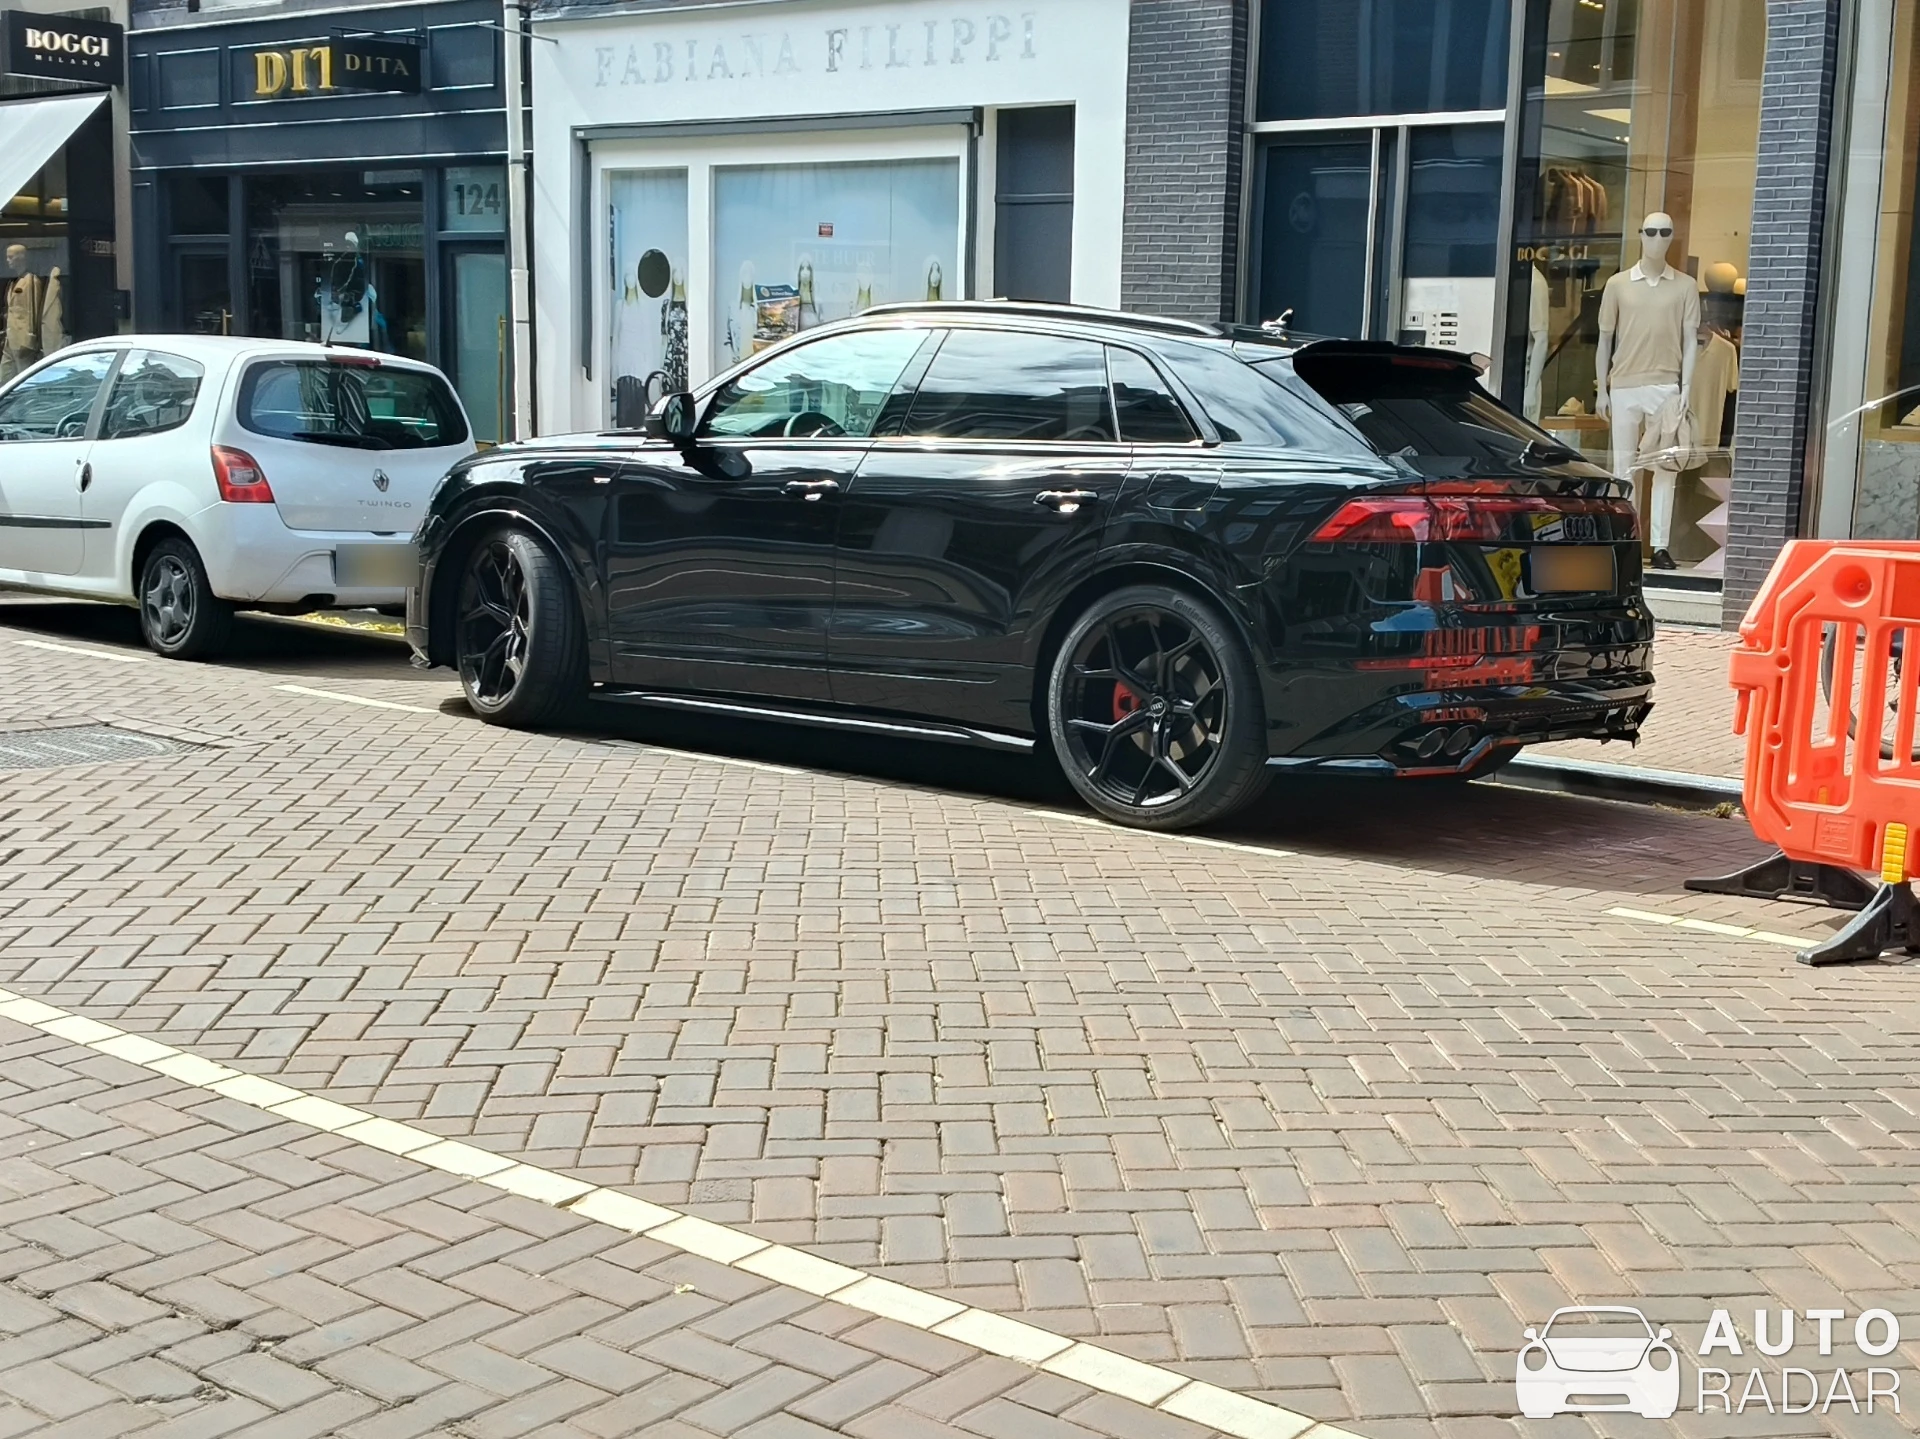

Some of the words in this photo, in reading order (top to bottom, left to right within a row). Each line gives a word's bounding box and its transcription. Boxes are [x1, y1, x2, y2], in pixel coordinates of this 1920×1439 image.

[25, 27, 110, 57] BOGGI
[594, 32, 802, 87] FABIANA
[824, 11, 1036, 73] FILIPPI
[34, 54, 101, 67] MILANO
[344, 53, 410, 76] DITA
[453, 183, 501, 215] 124
[357, 499, 412, 509] TWINGO
